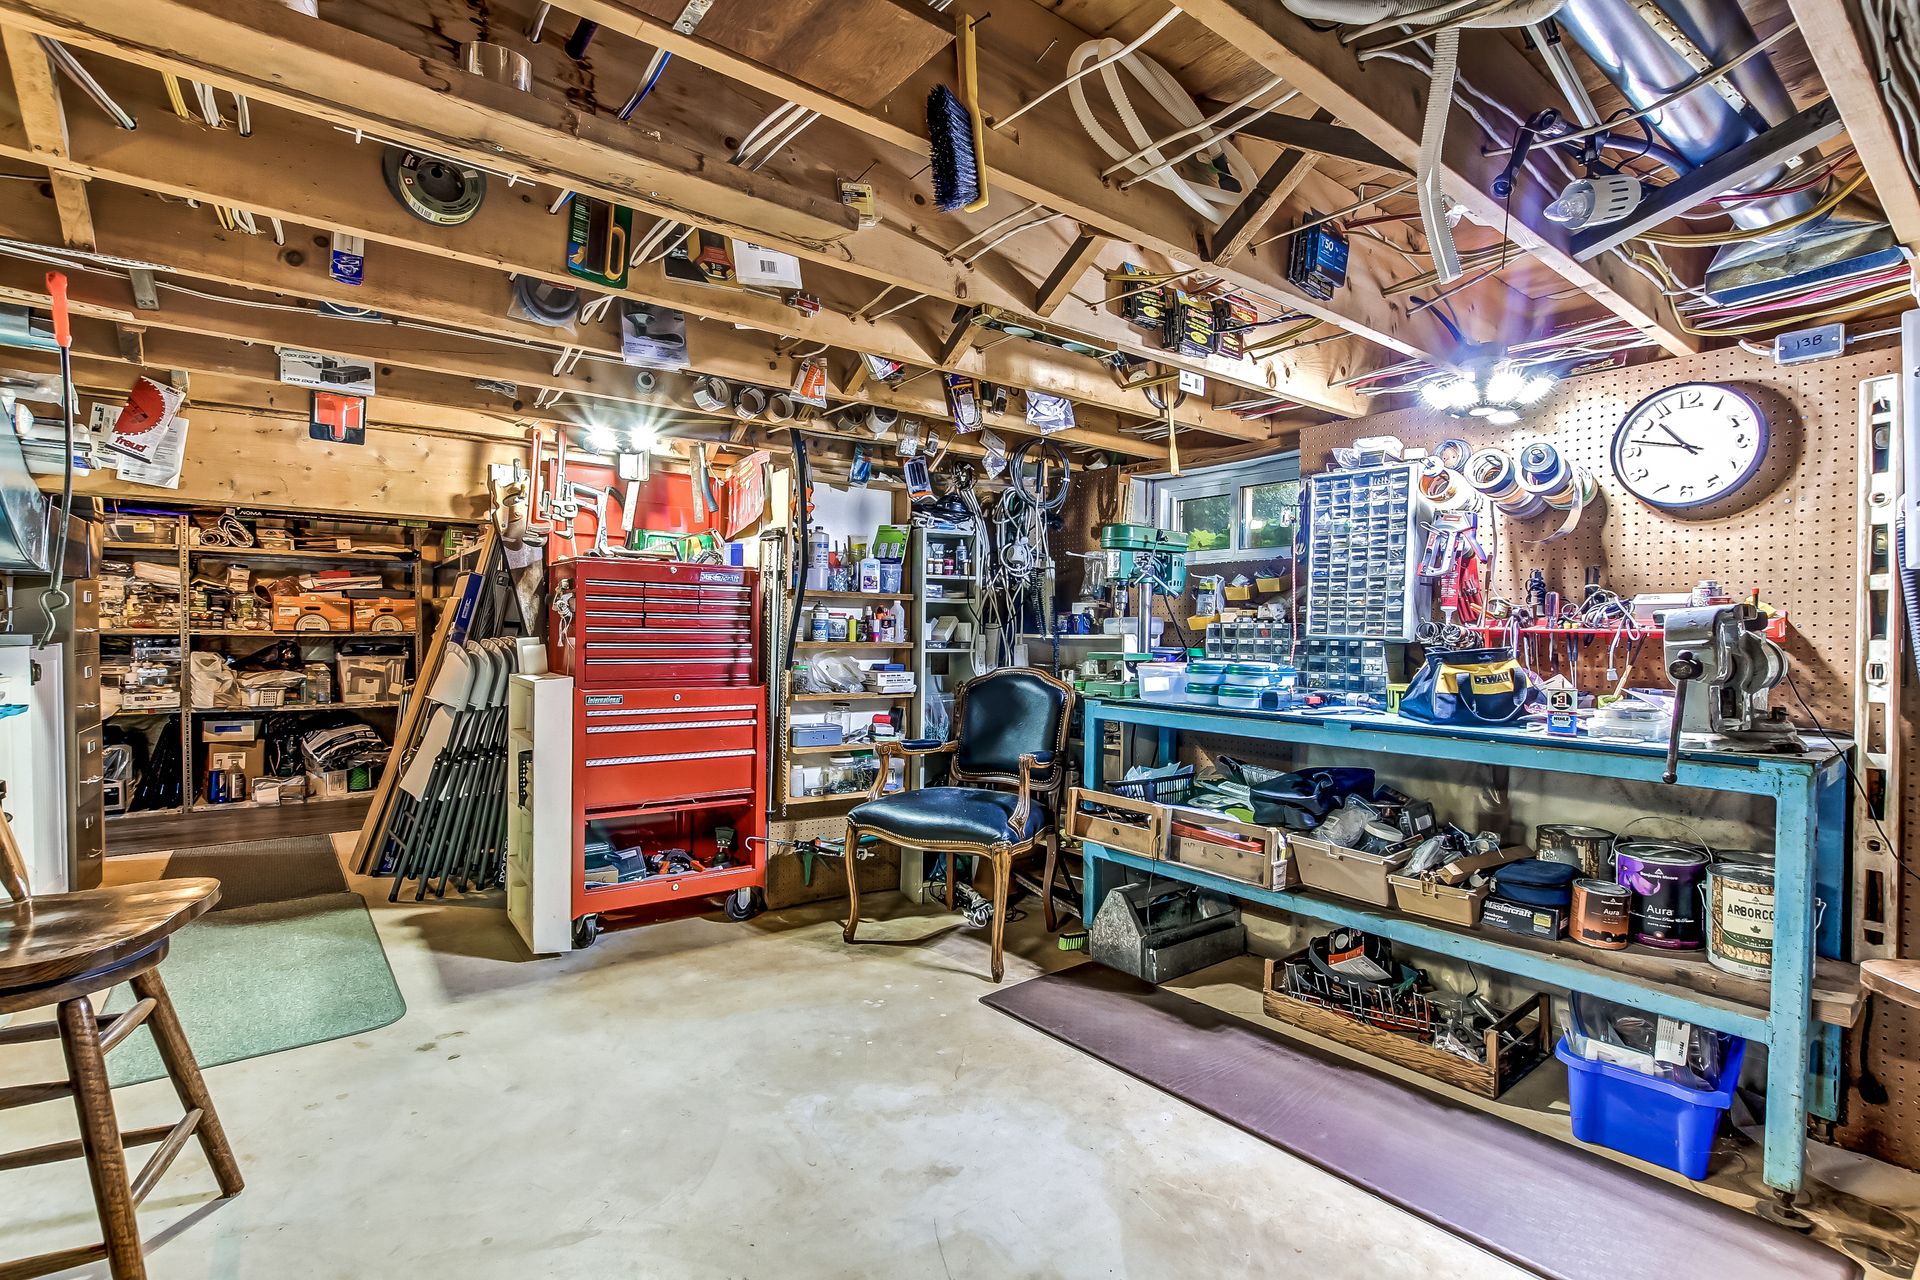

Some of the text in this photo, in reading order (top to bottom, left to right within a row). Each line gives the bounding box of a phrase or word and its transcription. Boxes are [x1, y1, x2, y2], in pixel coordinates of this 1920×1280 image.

[1795, 334, 1823, 350] 13B
[1678, 391, 1704, 410] 12
[115, 435, 149, 453] freud
[1474, 671, 1510, 684] DEWALT
[1484, 900, 1533, 918] Mastercraft
[1603, 908, 1620, 916] Aura
[1646, 904, 1673, 917] Aura
